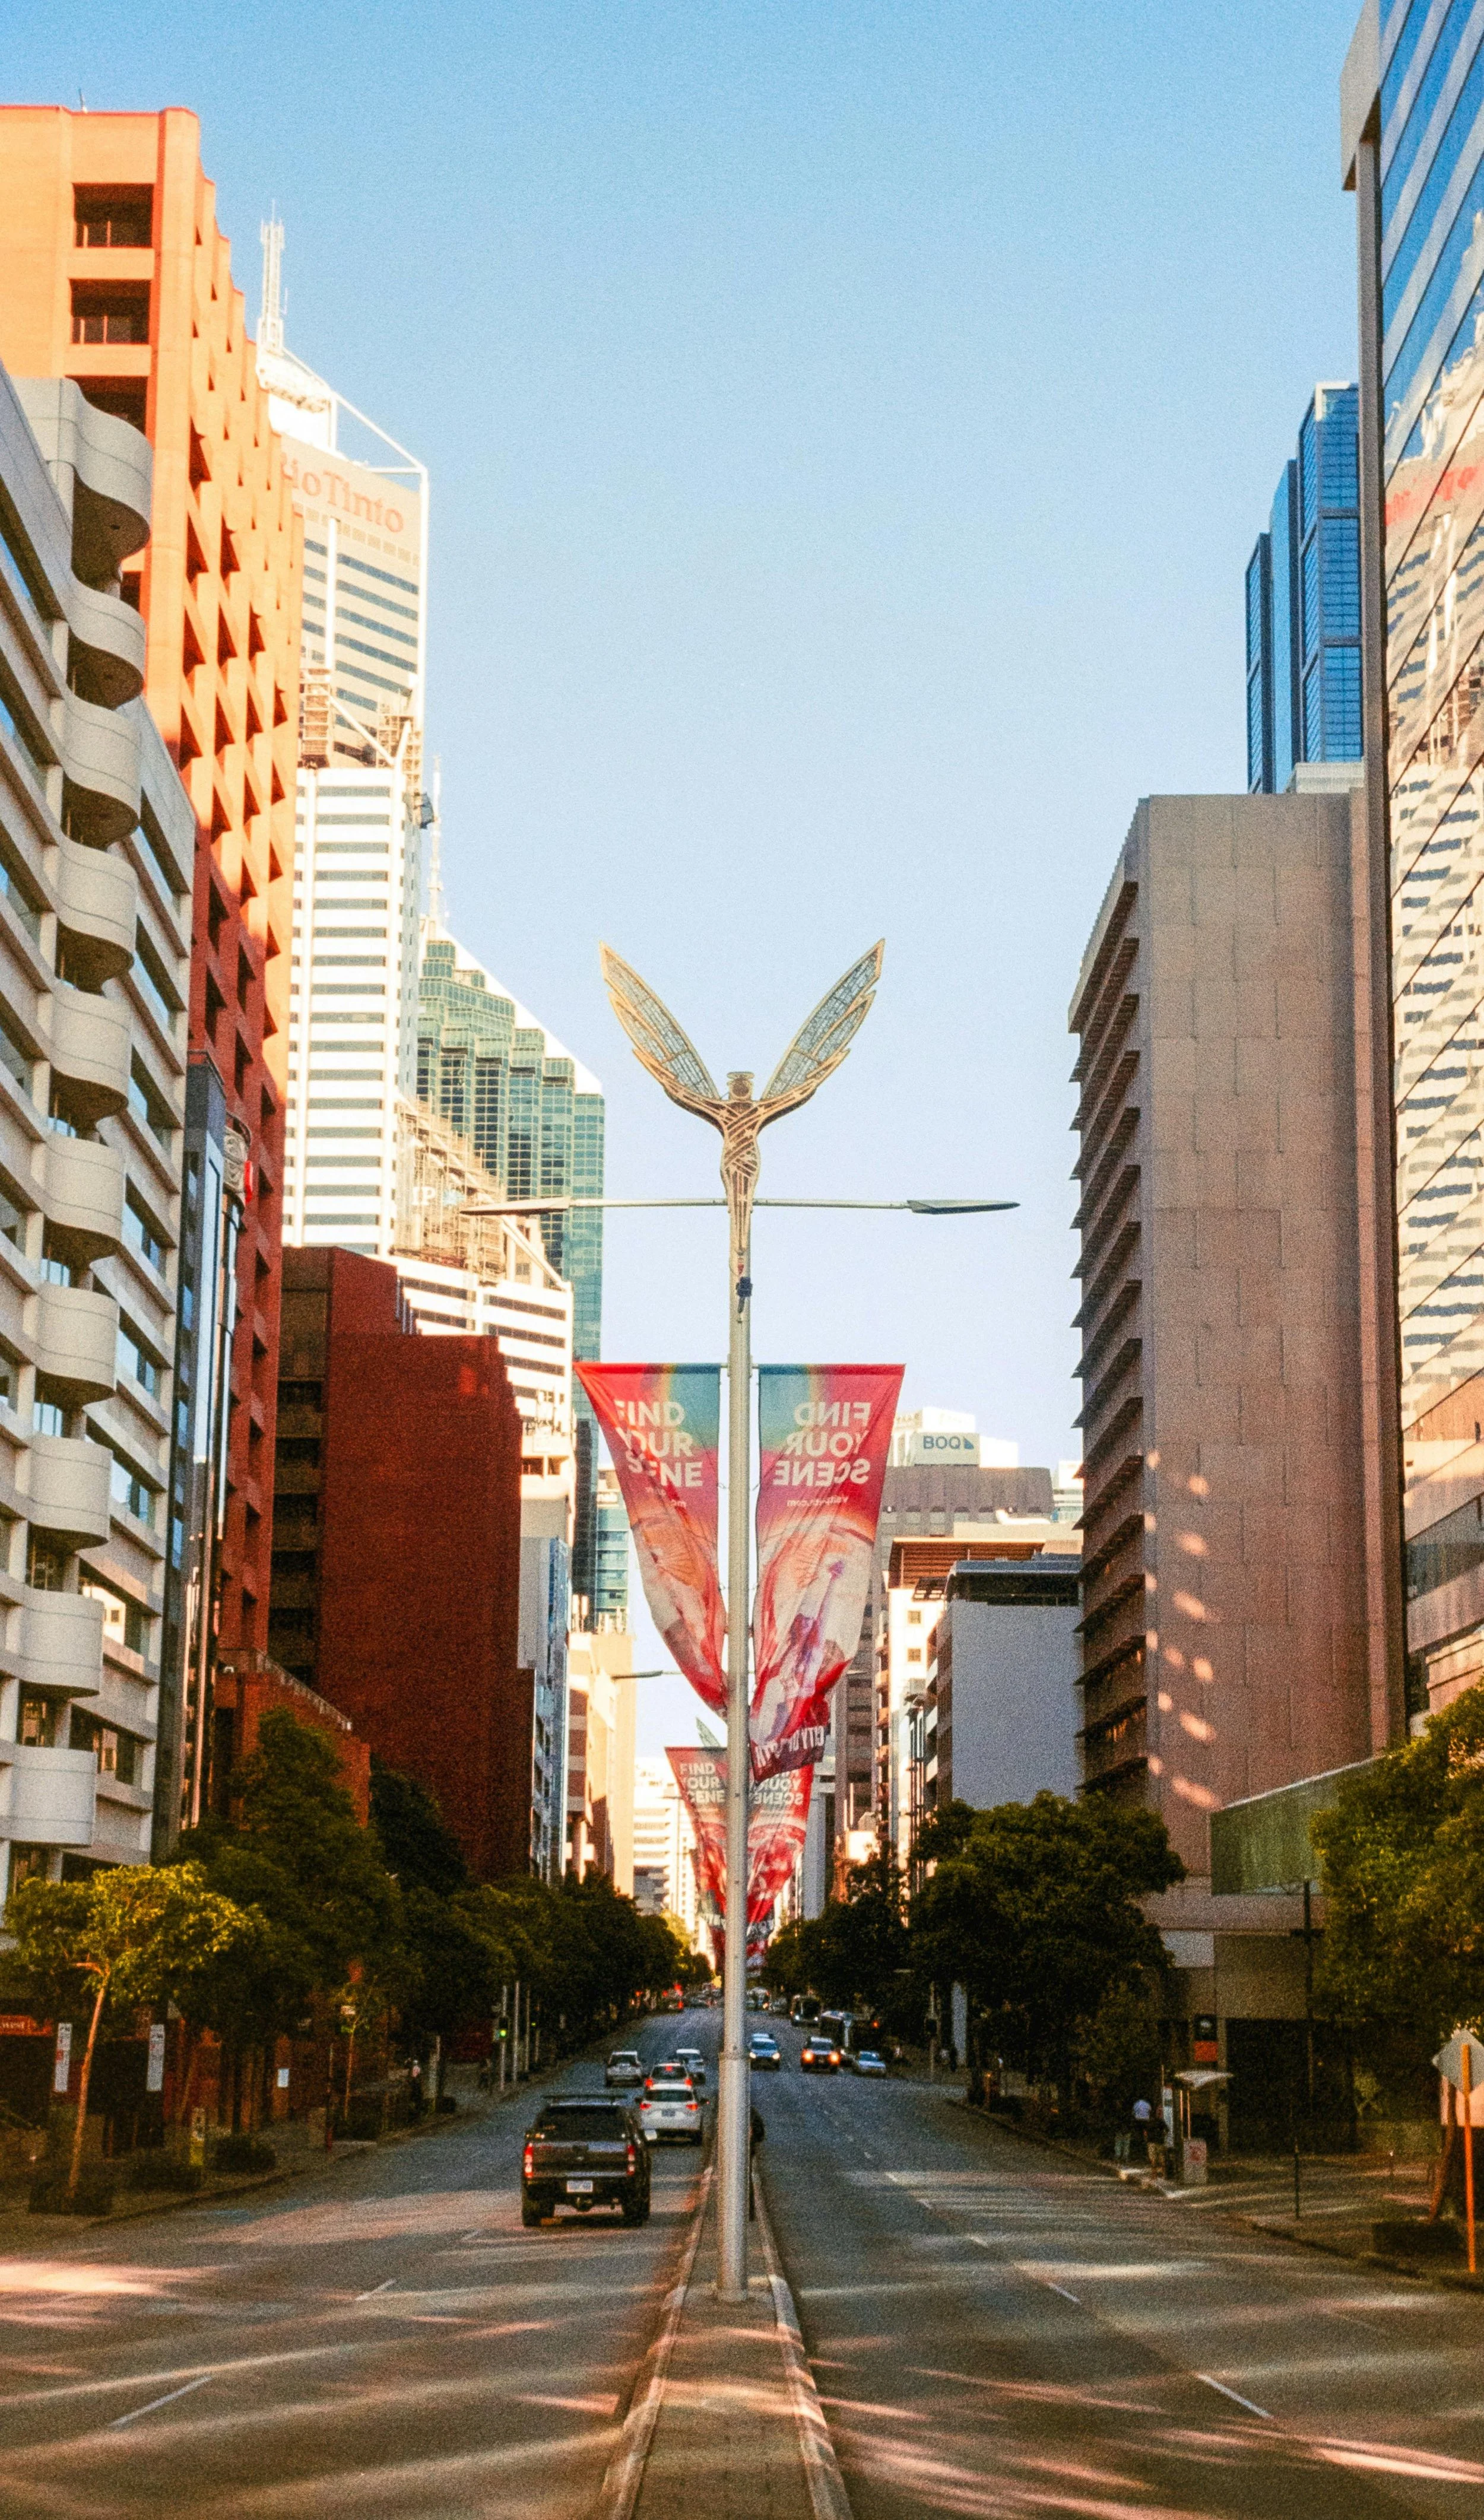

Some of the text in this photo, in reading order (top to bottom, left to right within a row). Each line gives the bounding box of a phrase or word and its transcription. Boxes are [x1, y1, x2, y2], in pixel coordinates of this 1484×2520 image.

[923, 1436, 961, 1449] BOQ
[625, 1450, 703, 1487] SNE
[679, 1763, 716, 1775] FIND
